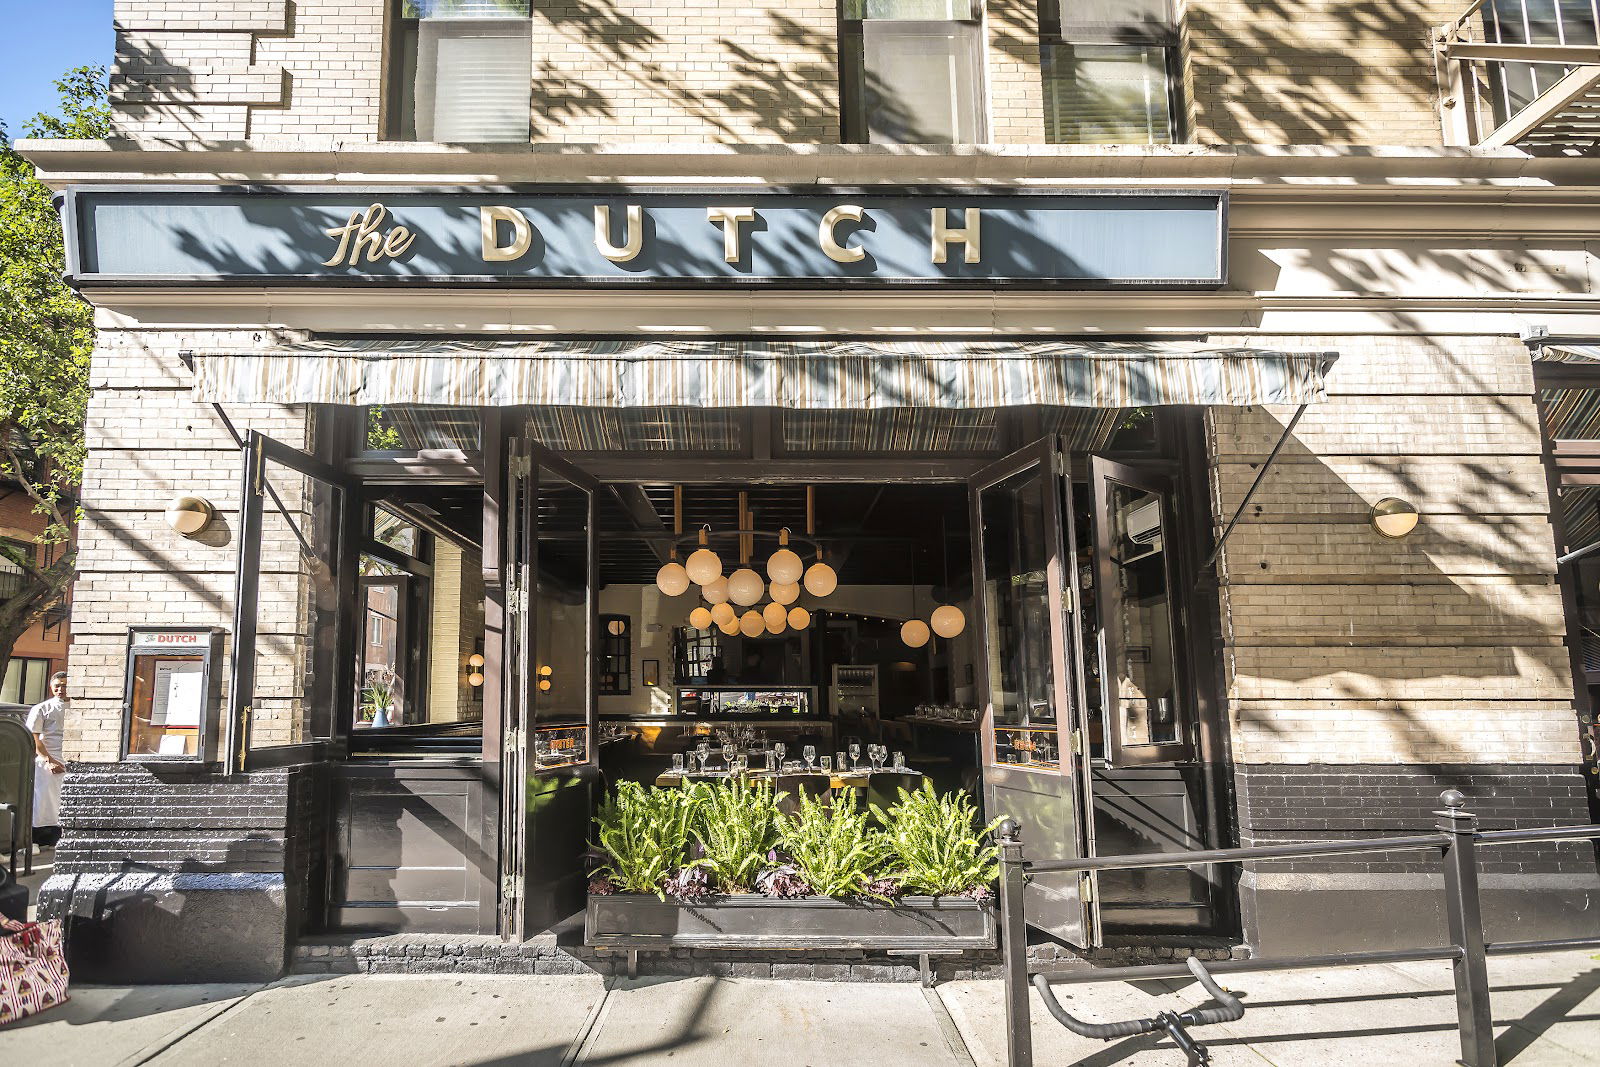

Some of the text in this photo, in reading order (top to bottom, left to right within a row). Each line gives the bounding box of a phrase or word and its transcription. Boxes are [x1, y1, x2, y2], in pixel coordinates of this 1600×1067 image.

[321, 203, 981, 267] the DUTCH
[157, 634, 197, 643] DUTCH
